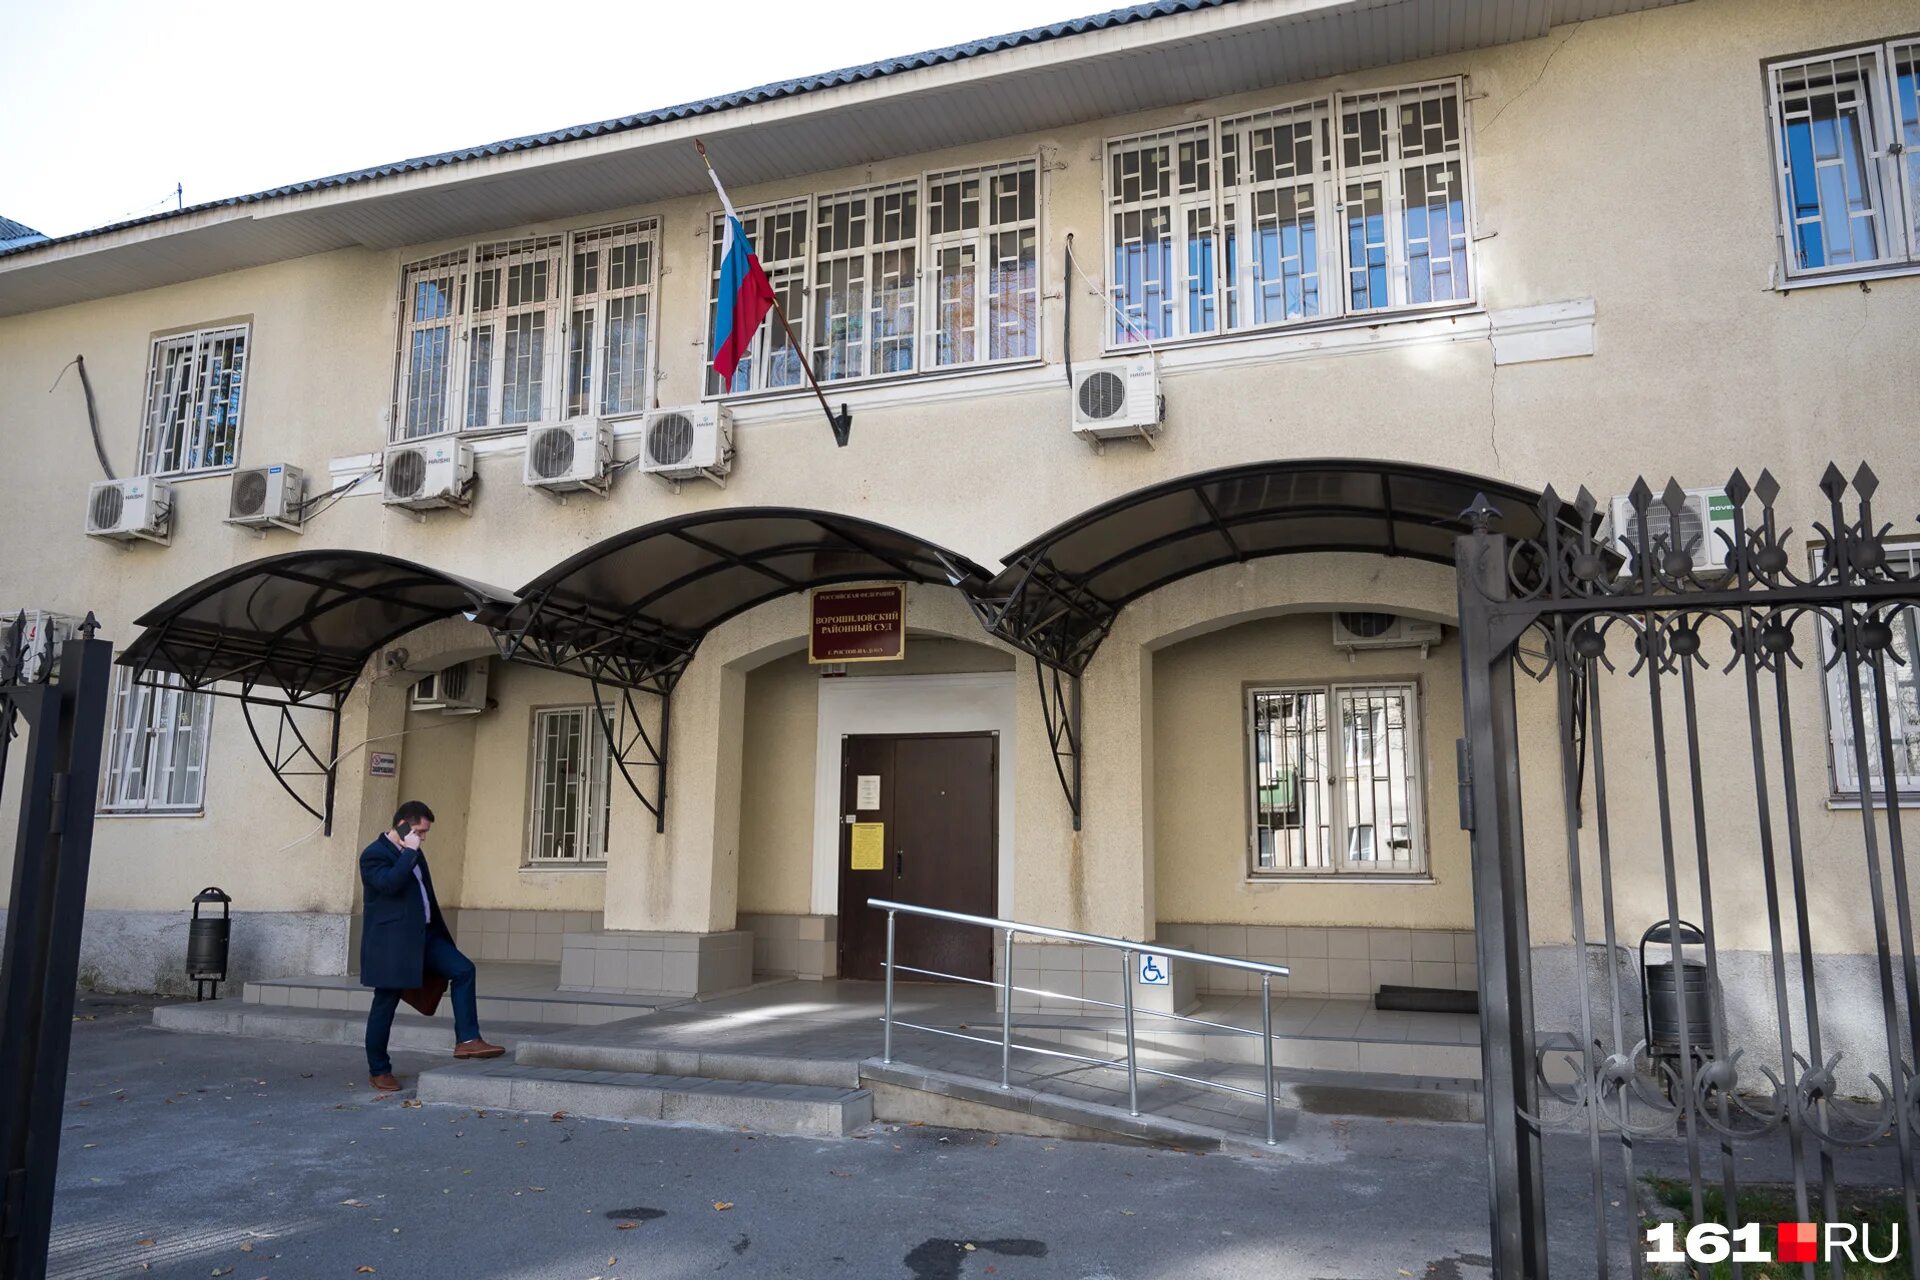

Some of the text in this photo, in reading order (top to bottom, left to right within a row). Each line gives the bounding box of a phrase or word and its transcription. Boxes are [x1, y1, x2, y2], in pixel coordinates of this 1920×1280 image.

[815, 612, 898, 624] ВОРОШИЛОВСКИЙ
[821, 622, 892, 634] РАЙОННЫЙ СУД
